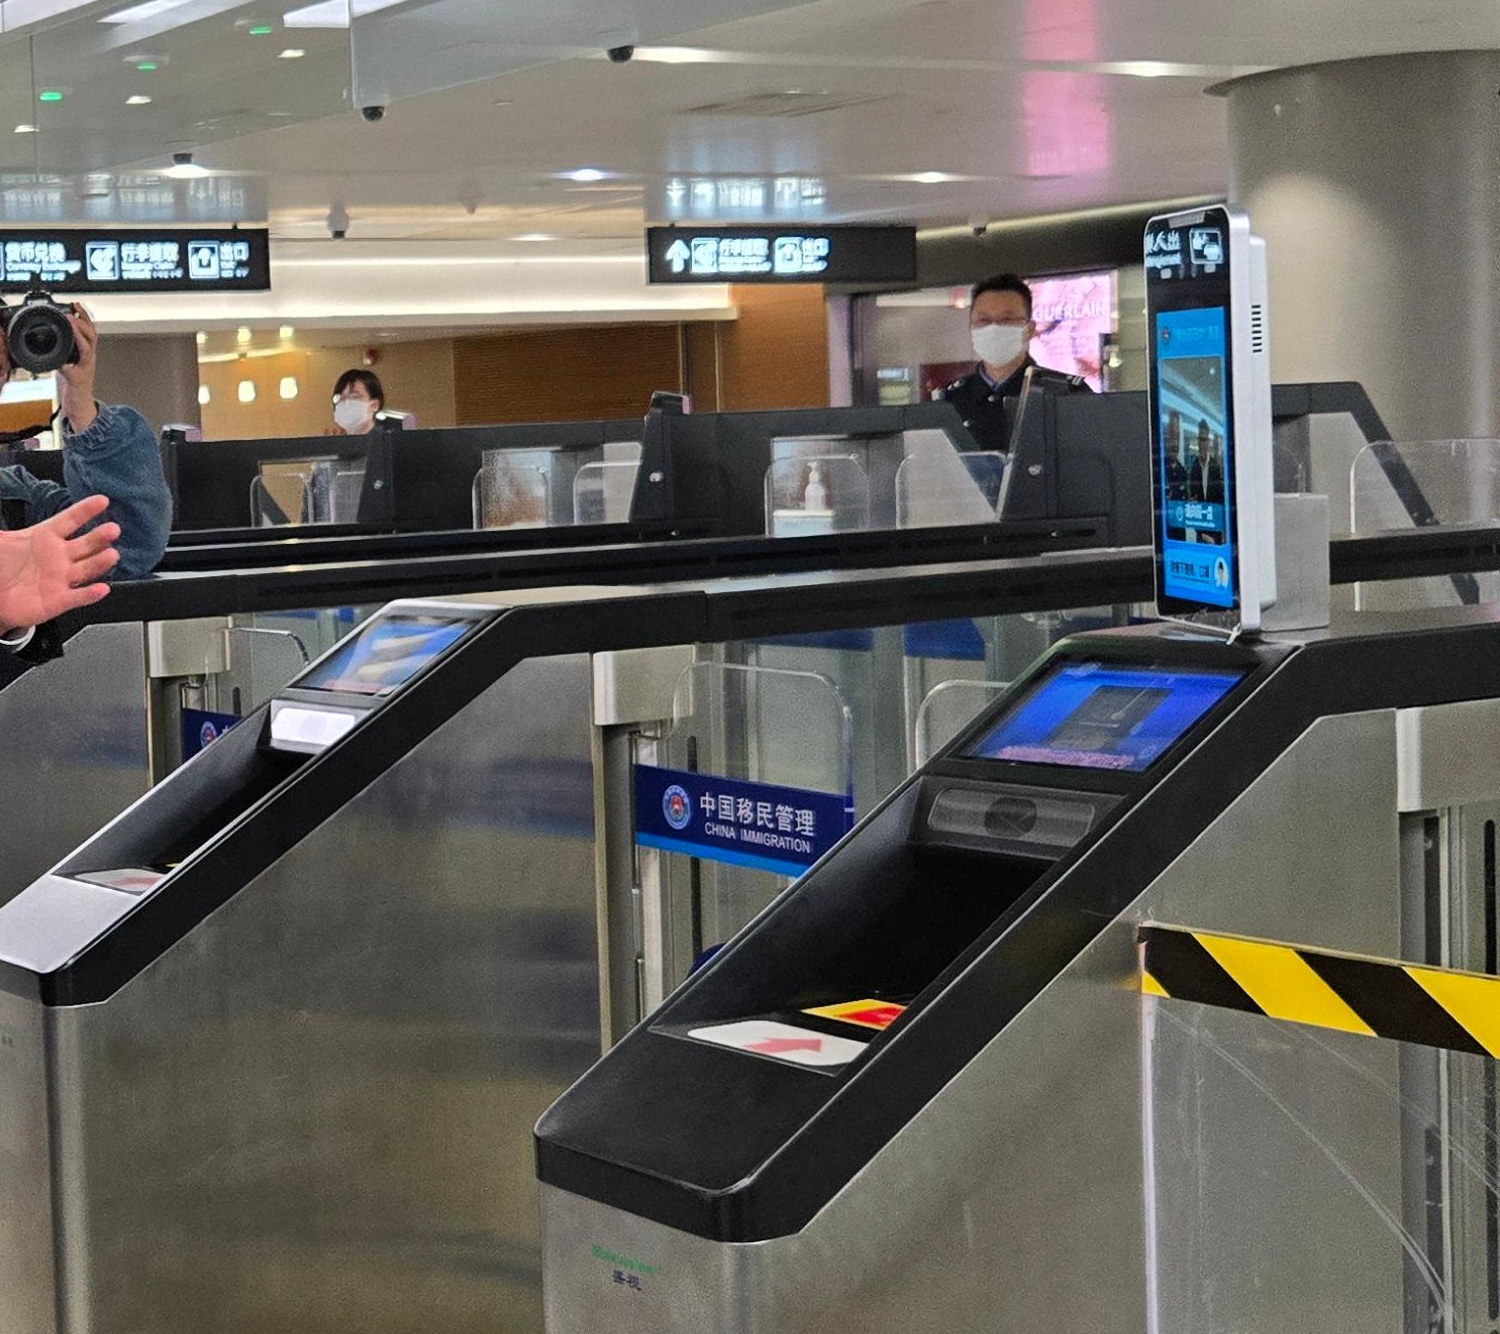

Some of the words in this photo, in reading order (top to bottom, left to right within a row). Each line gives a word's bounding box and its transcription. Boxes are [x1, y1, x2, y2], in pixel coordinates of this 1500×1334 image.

[219, 241, 250, 261] 出口
[1033, 300, 1106, 322] GUERLAIN
[700, 792, 816, 836] 中国移民管理
[705, 821, 736, 840] CHINA
[740, 826, 811, 854] IMMIGRATION
